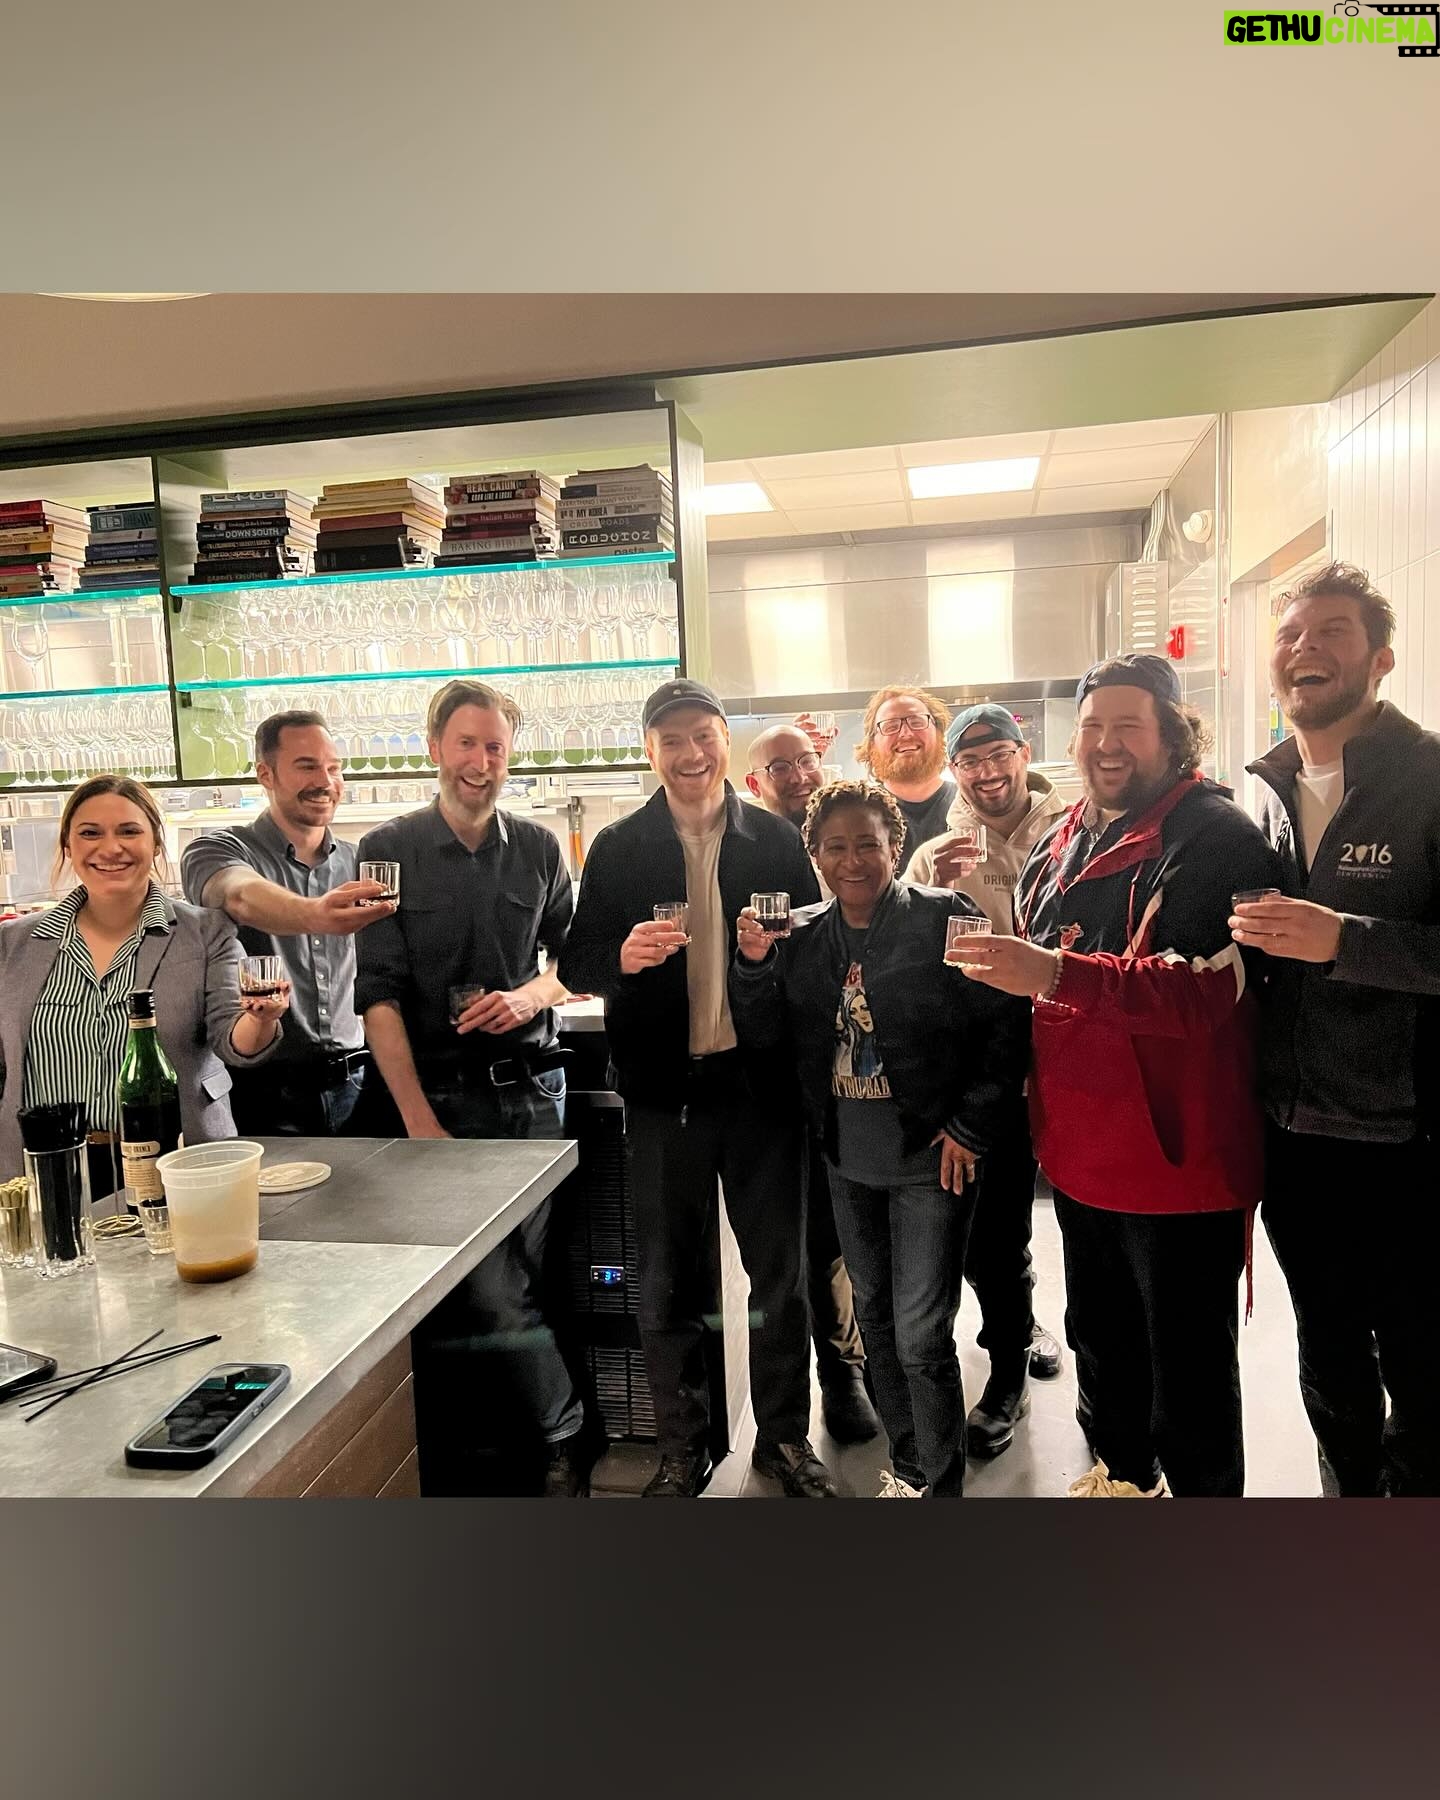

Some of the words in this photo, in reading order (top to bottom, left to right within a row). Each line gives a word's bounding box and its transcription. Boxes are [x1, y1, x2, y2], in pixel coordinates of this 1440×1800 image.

[225, 529, 251, 539] DOWN
[252, 527, 279, 537] SOUTH
[569, 530, 650, 544] ROBUCHON
[451, 541, 492, 552] BAKING
